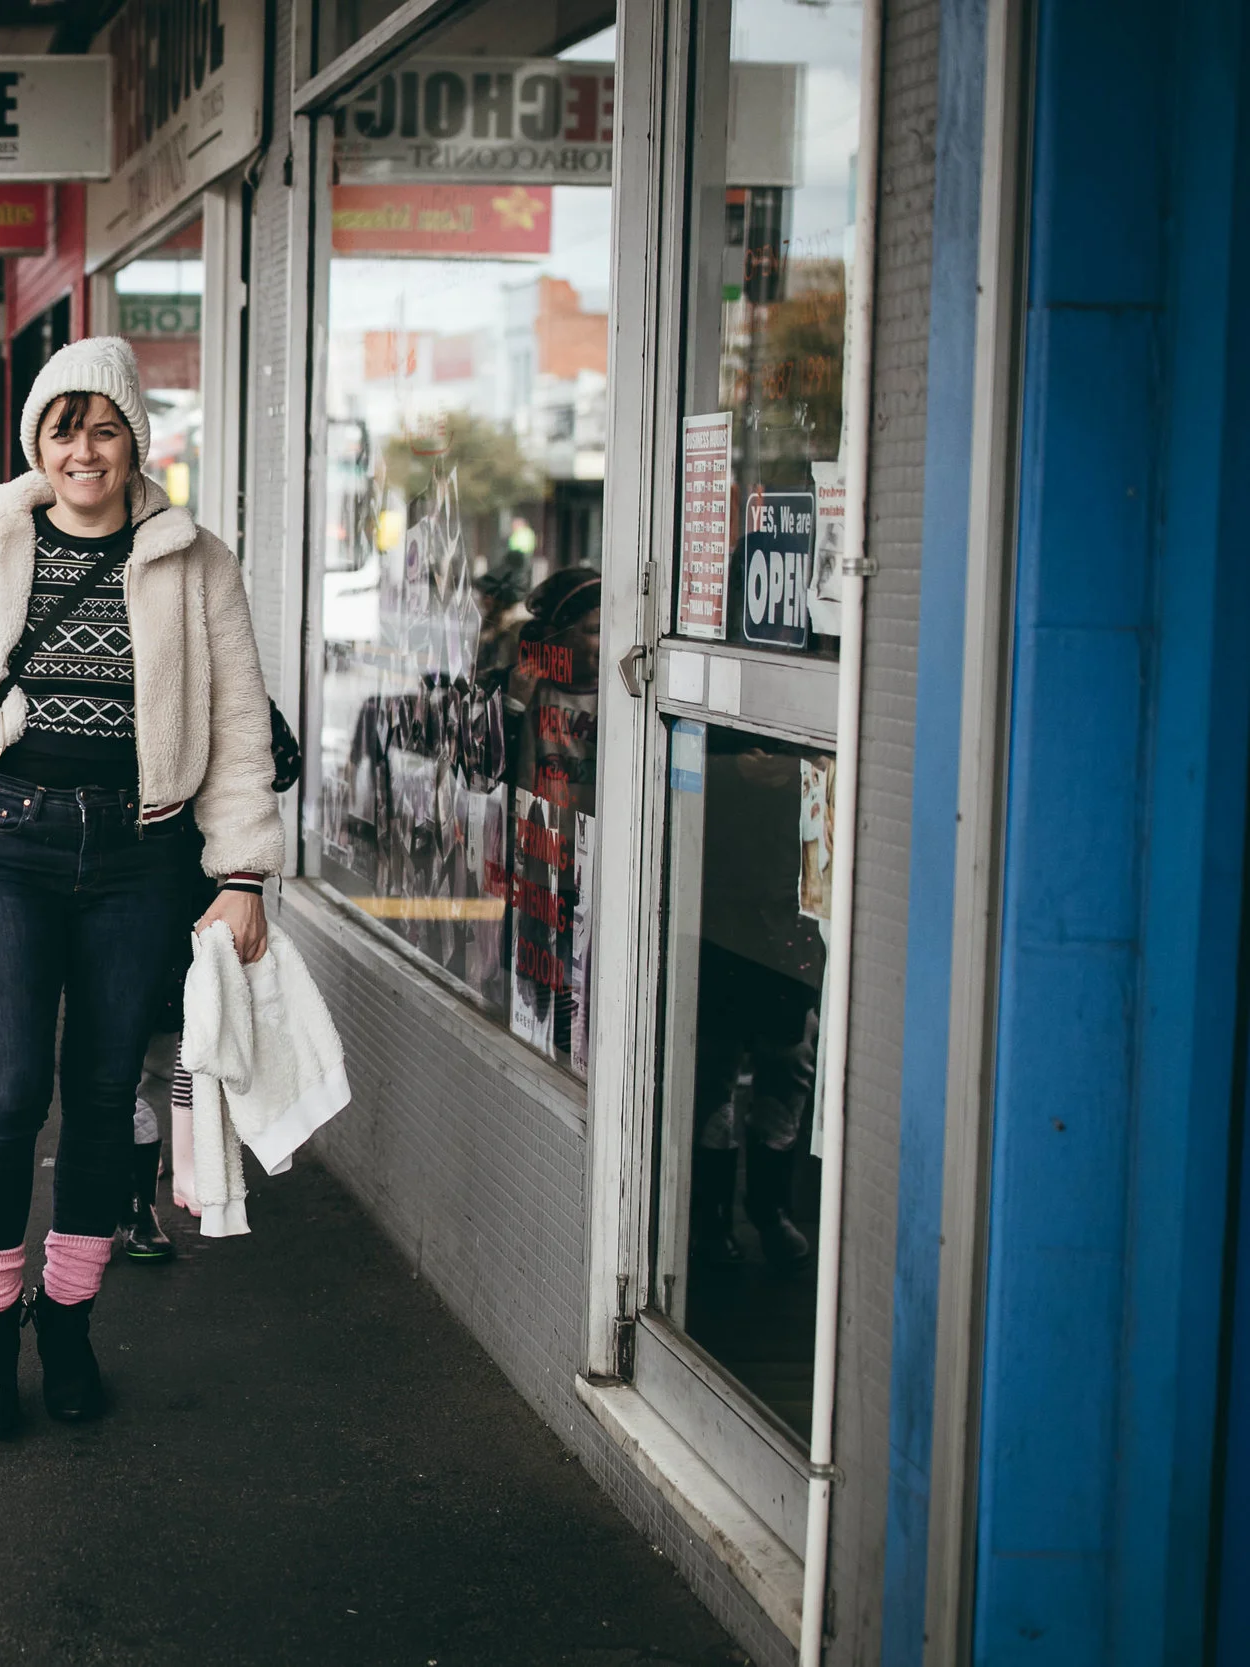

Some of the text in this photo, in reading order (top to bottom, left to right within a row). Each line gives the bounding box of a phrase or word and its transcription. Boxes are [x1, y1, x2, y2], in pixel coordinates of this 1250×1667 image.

[751, 505, 777, 539] YES,
[781, 506, 794, 534] We
[796, 511, 811, 535] are
[747, 549, 809, 629] OPEN
[518, 639, 574, 684] CHILDREN
[518, 936, 565, 996] COLOUR
